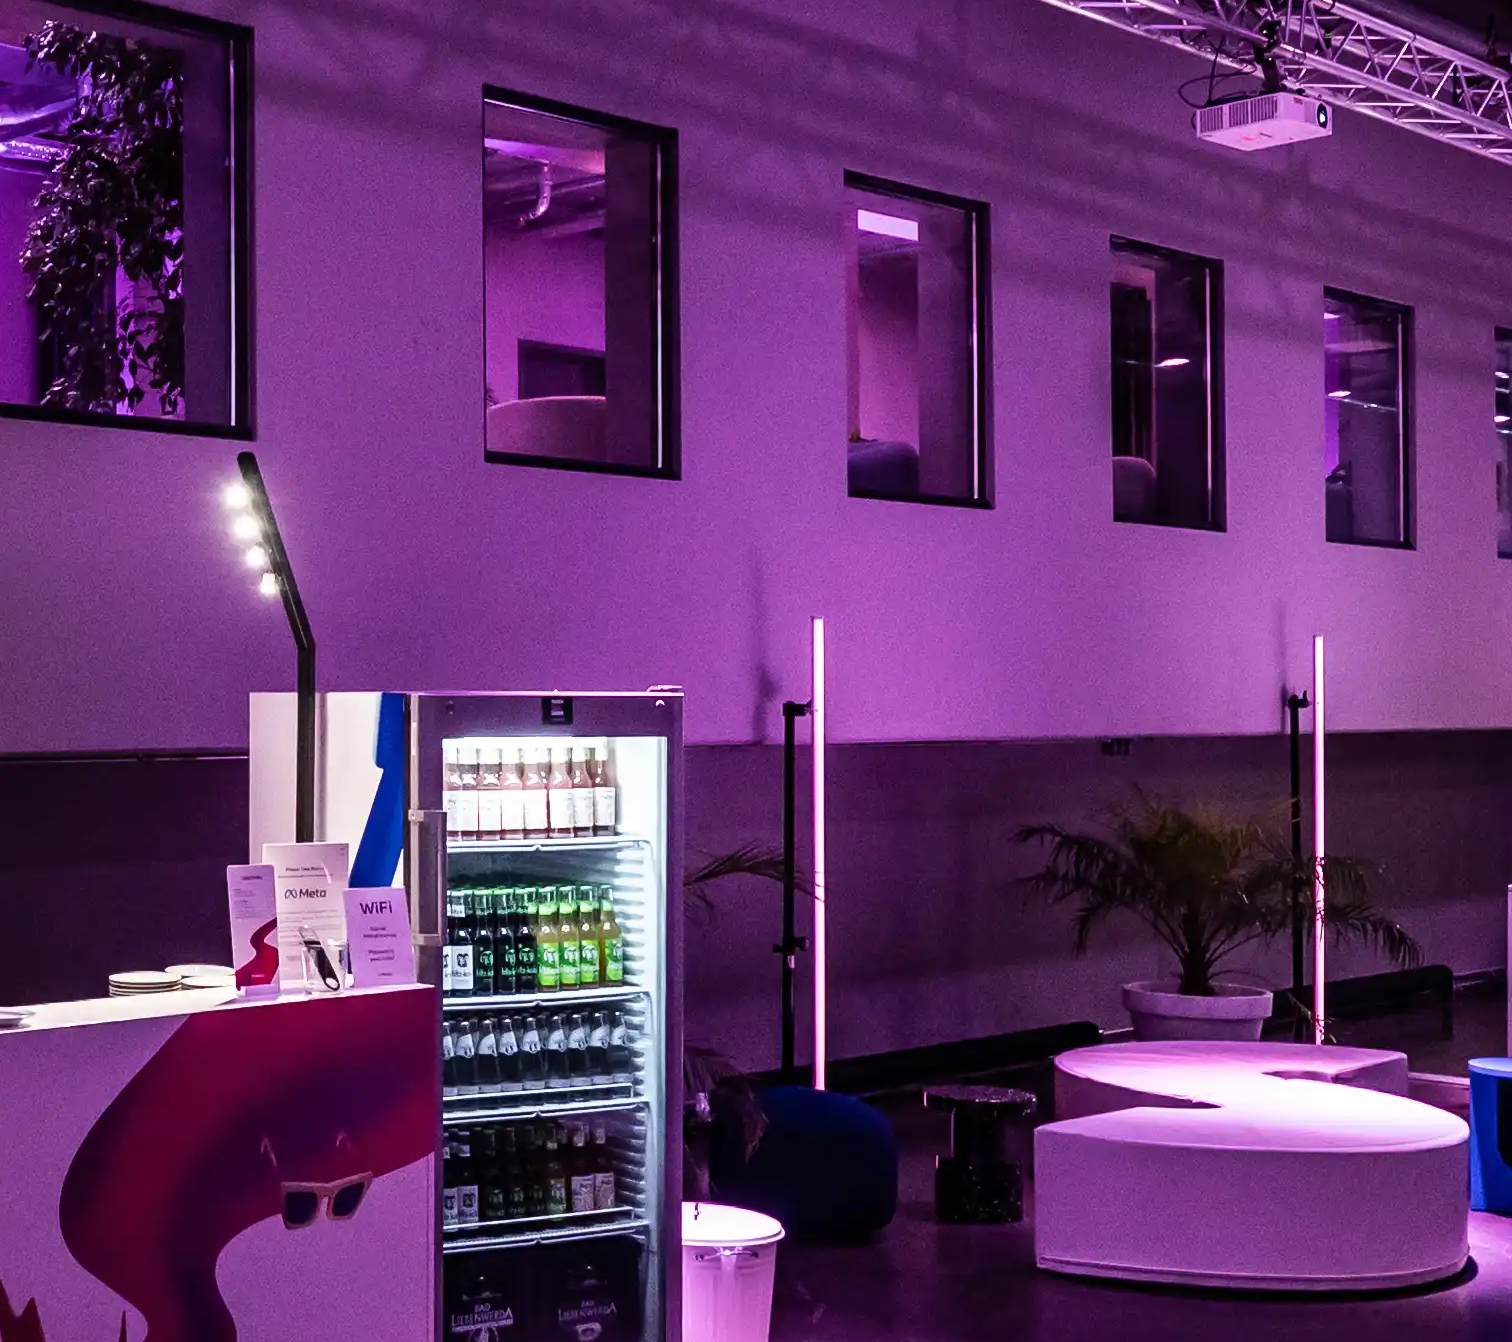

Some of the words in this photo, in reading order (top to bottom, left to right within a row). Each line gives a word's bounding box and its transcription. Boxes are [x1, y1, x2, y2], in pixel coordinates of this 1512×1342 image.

[299, 887, 327, 899] Meta
[359, 900, 394, 915] WiFi
[474, 1302, 491, 1313] BAD
[451, 1307, 514, 1327] LIEBENWERDA
